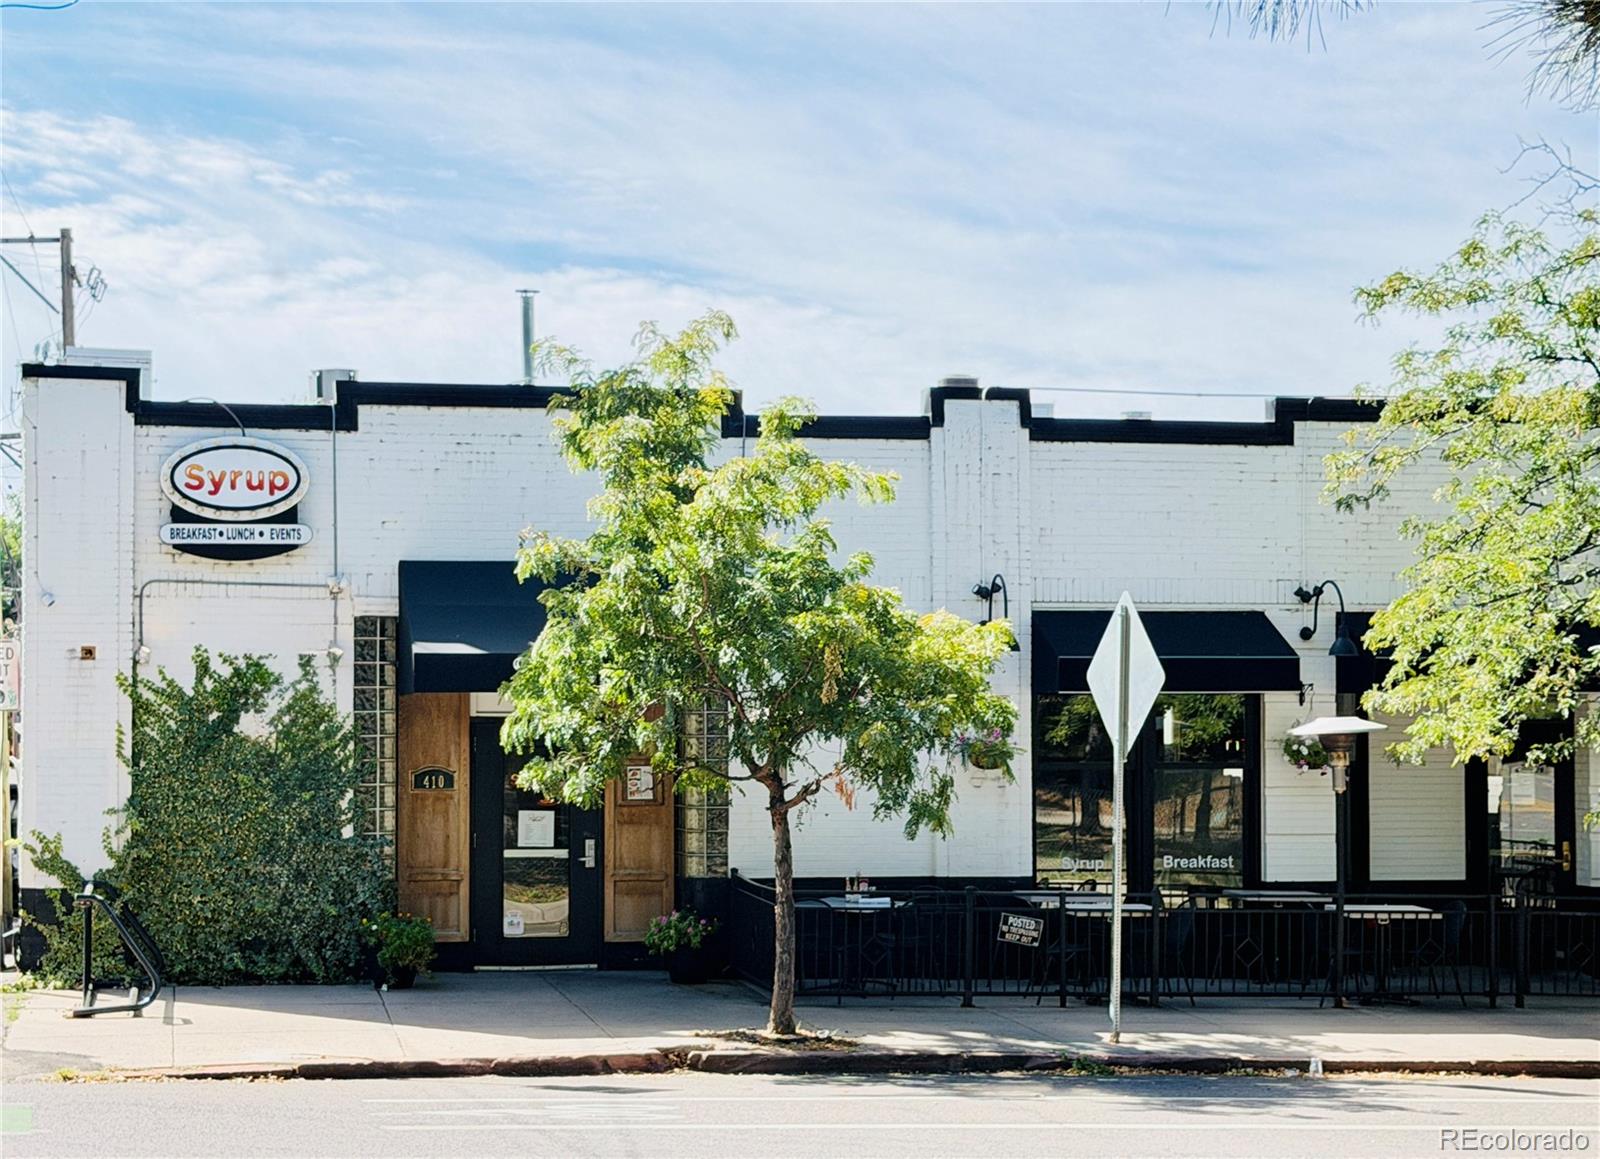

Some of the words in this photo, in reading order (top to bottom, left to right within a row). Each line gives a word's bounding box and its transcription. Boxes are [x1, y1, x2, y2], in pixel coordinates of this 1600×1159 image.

[184, 463, 290, 496] Syrup
[169, 527, 217, 540] BREAKFAST
[226, 527, 255, 540] LUNCH
[269, 528, 302, 541] EVENTS
[423, 775, 445, 789] 410
[1061, 857, 1105, 873] Syrup
[1162, 854, 1234, 869] Breakfast
[1008, 916, 1036, 930] POSTED
[1005, 932, 1020, 941] KEEP
[1020, 935, 1033, 944] OUT
